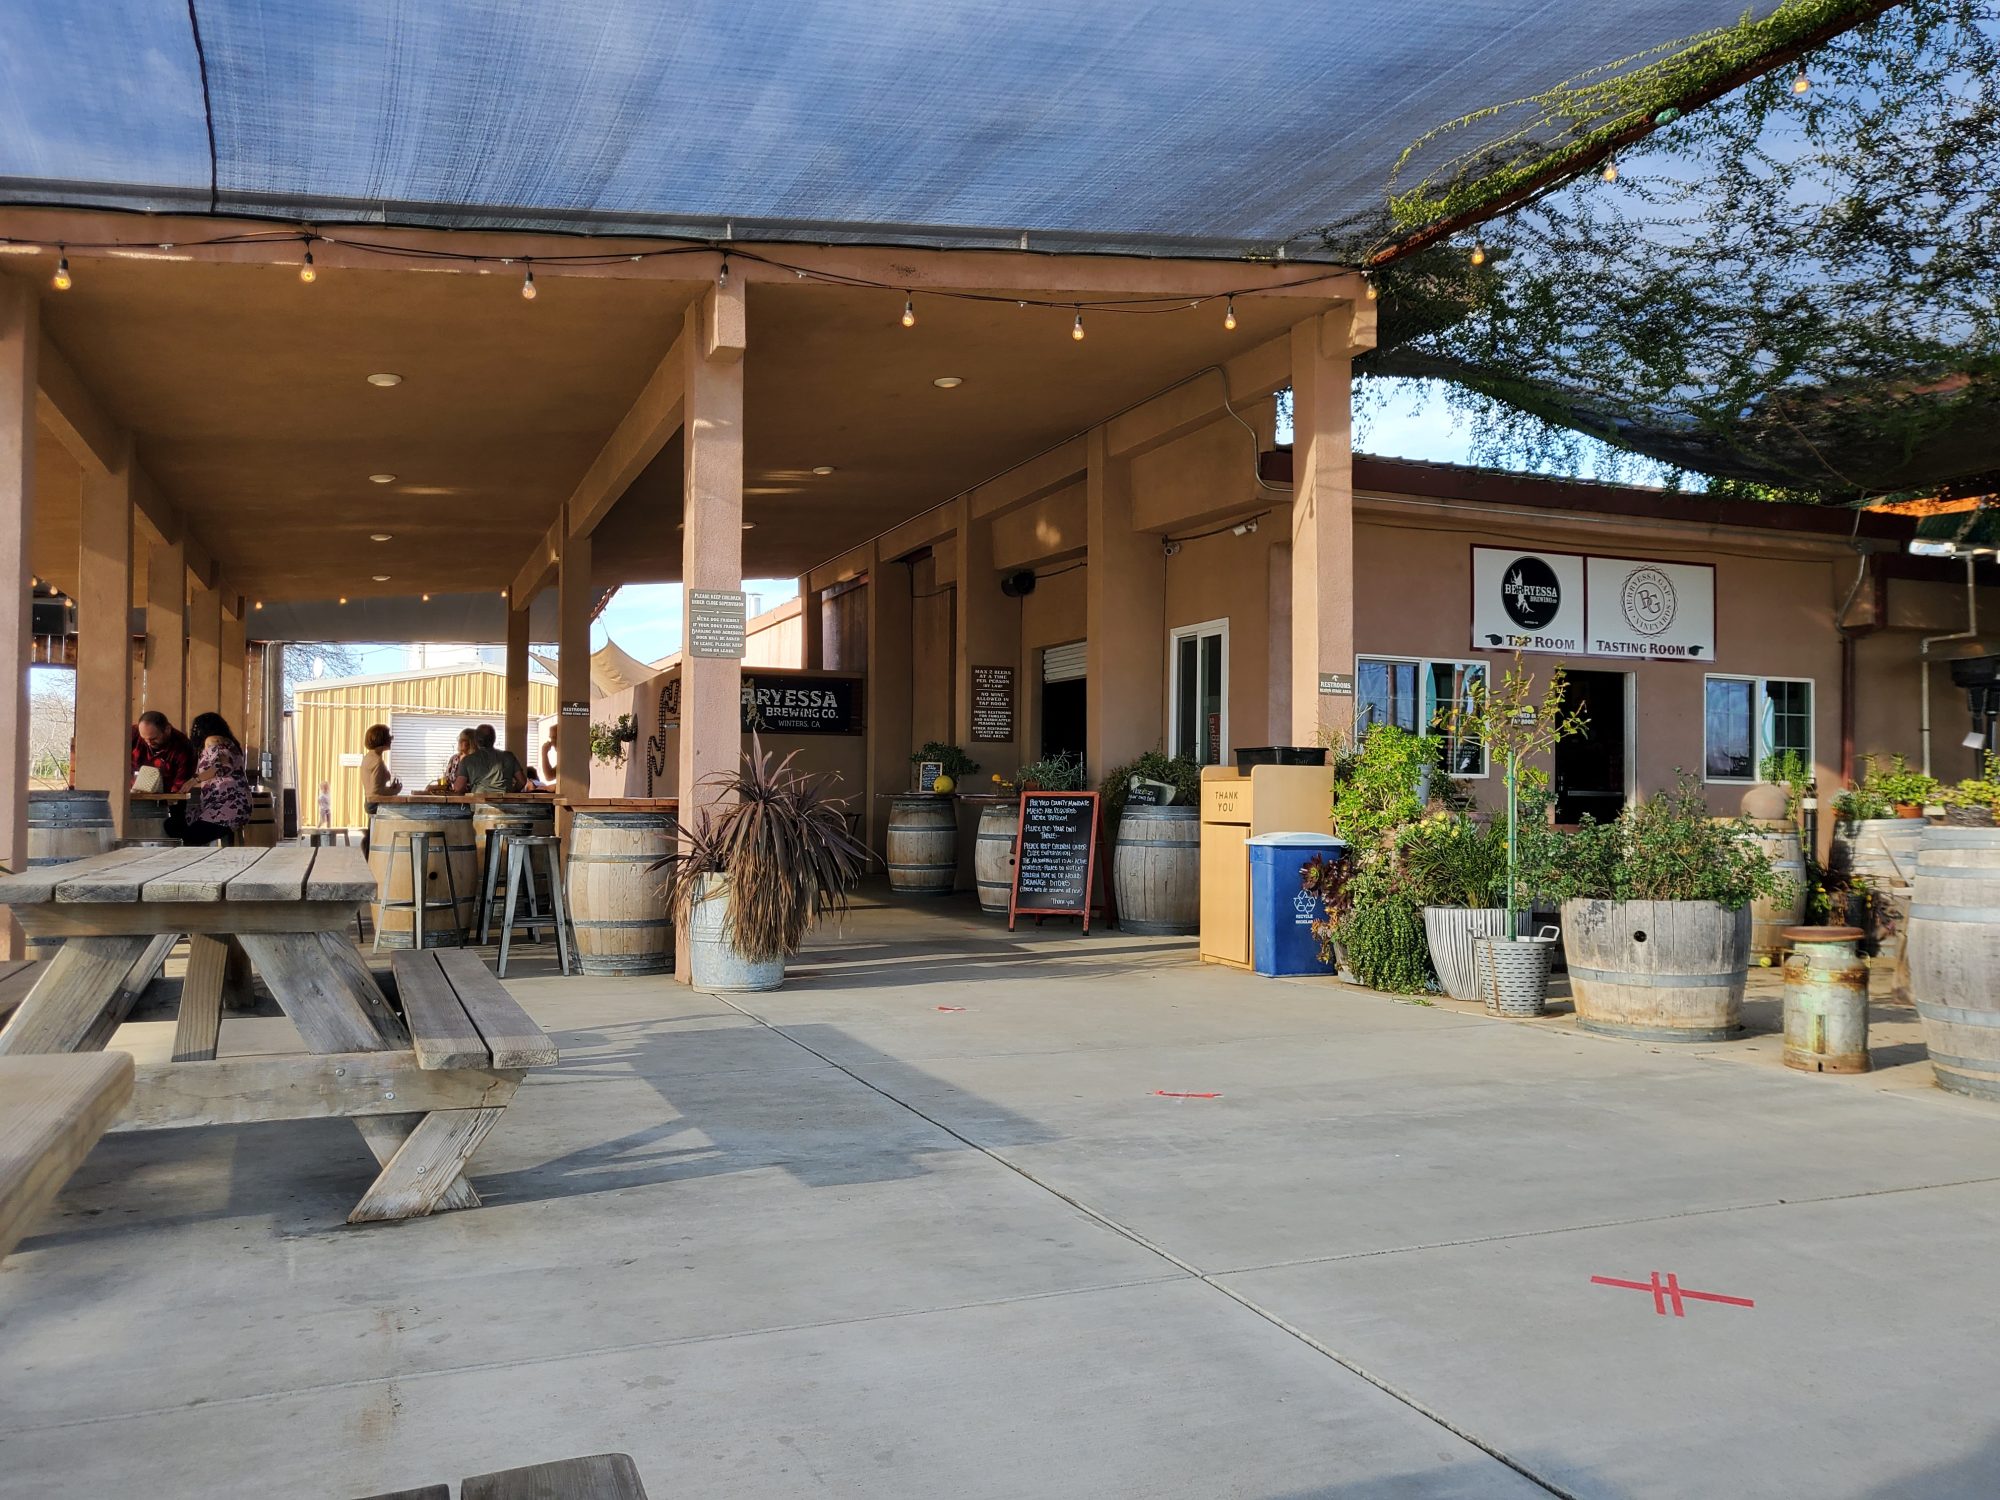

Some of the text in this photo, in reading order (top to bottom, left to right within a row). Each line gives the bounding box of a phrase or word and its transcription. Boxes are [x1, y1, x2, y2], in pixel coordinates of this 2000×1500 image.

[1504, 583, 1558, 598] BERRYESSA
[1626, 574, 1671, 612] BERRYESSA GAP
[1635, 605, 1672, 630] VINEYARDS
[1535, 636, 1575, 650] ROOM
[1596, 640, 1686, 655] TASTING ROOM
[766, 707, 838, 719] BREWING CO.
[1029, 799, 1039, 807] PER
[1218, 802, 1234, 812] YOU
